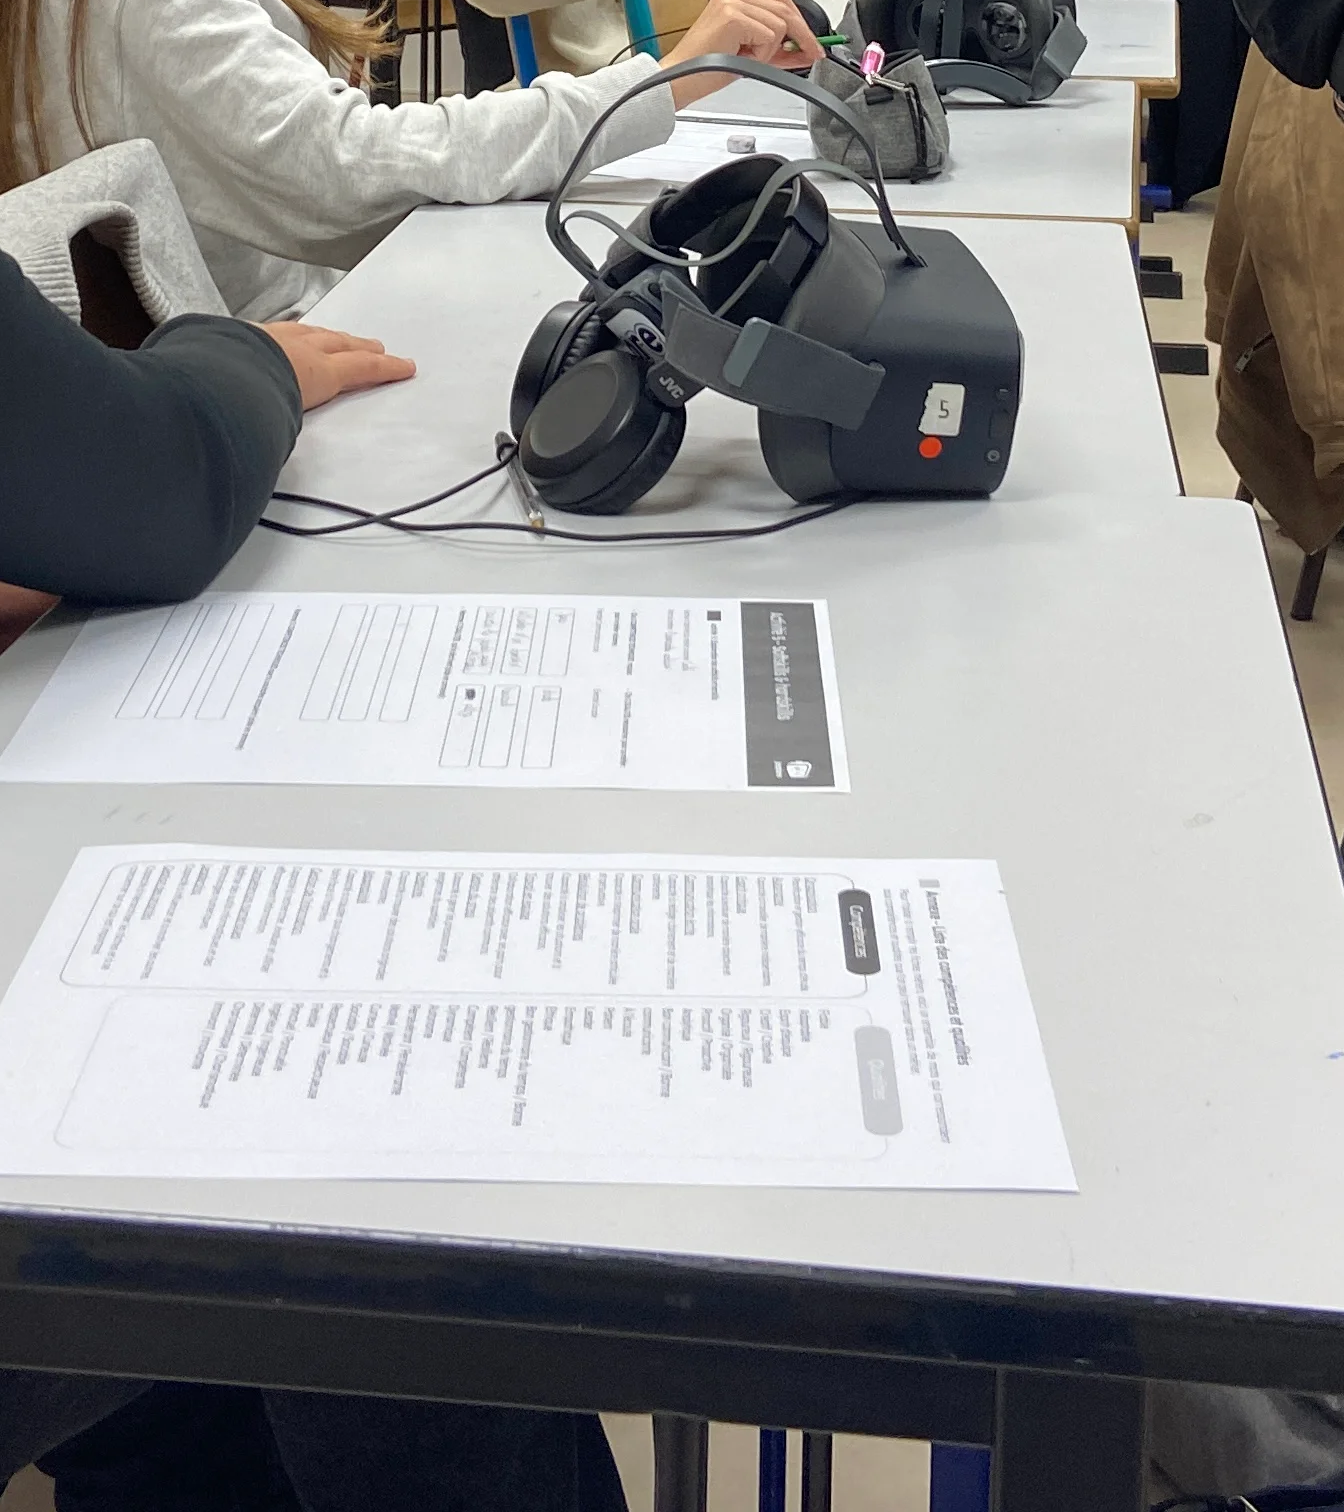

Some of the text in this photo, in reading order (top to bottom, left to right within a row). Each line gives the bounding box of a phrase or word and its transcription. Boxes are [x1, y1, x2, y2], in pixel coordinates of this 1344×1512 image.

[659, 375, 685, 400] JVC
[938, 400, 951, 419] 5
[770, 612, 787, 634] Activité
[926, 891, 940, 919] Annexe
[849, 905, 867, 957] Compétences
[932, 925, 946, 943] Liste
[935, 945, 950, 959] des
[939, 961, 959, 1014] compétences
